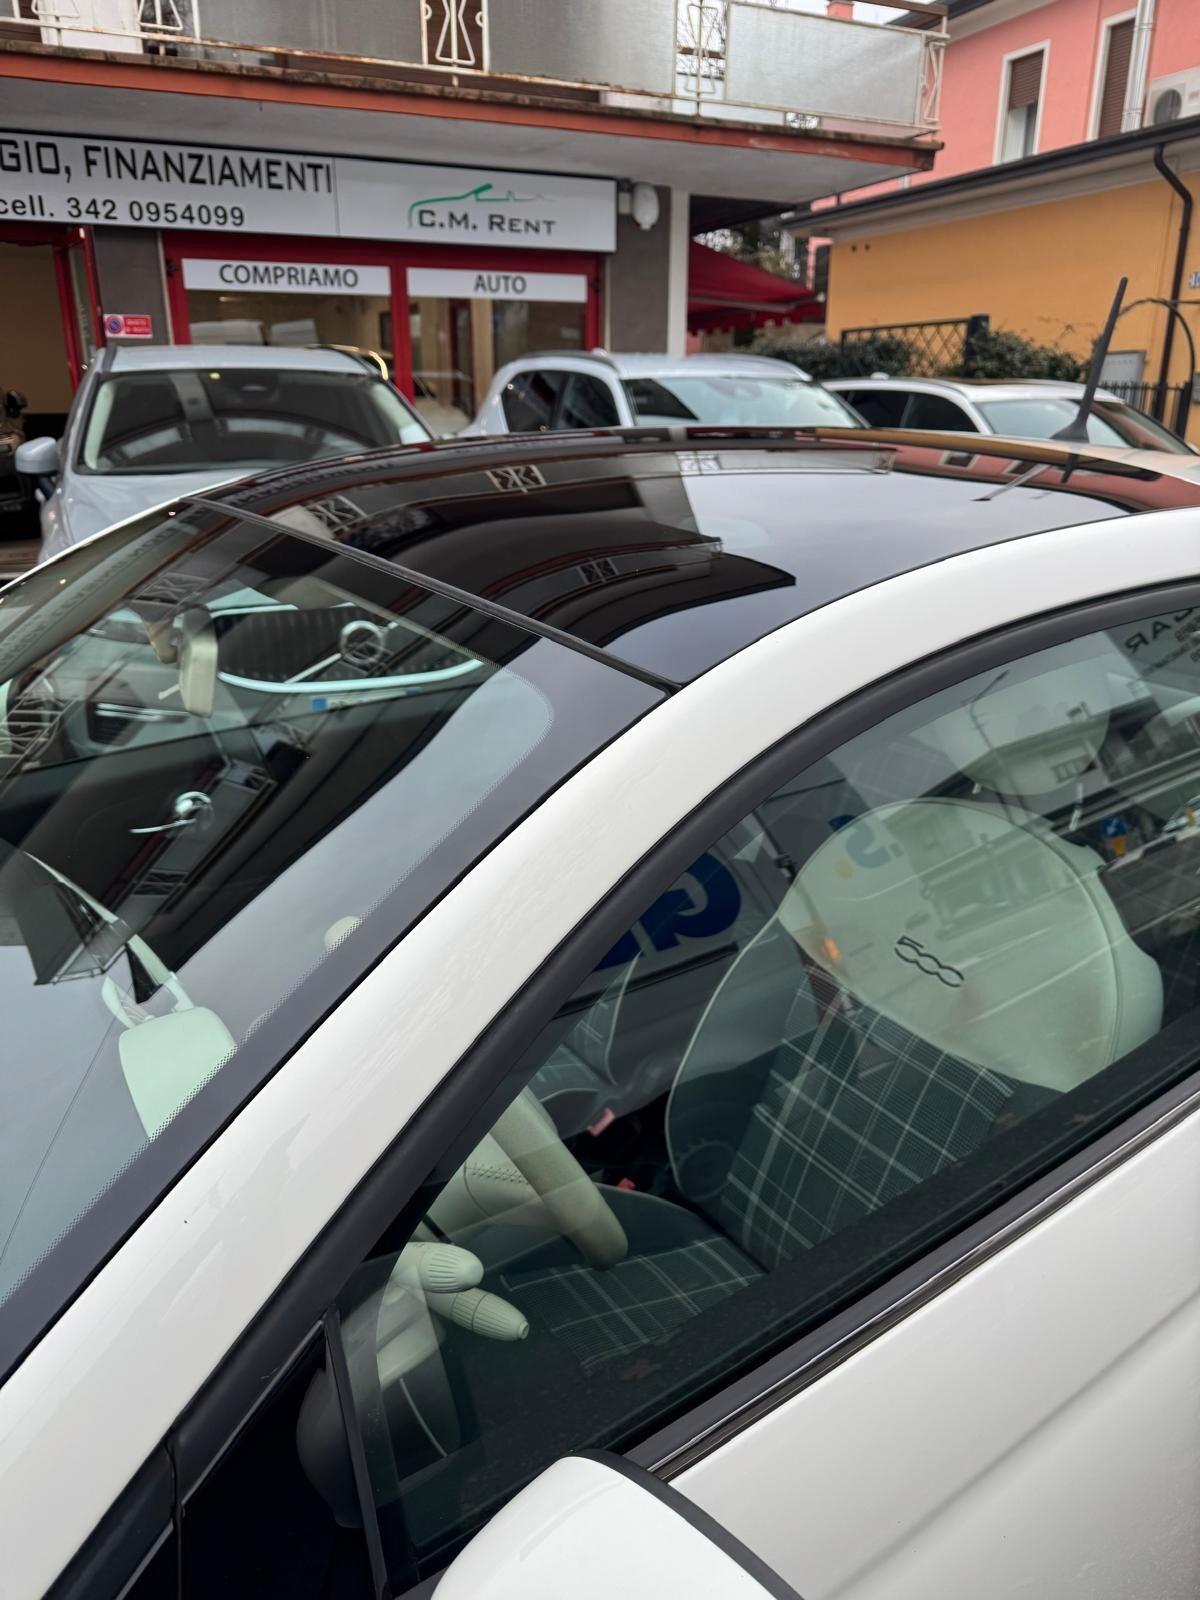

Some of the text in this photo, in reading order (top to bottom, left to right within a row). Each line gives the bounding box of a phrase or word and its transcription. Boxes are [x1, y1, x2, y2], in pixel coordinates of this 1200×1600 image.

[0, 139, 333, 193] GIO, FINANZIAMENTI
[66, 197, 118, 219] 342
[129, 200, 244, 226] 0954099
[419, 209, 556, 235] C.M. RENT
[219, 263, 359, 288] COMPRIAMO
[474, 273, 527, 294] AUTO
[895, 936, 964, 988] 500
